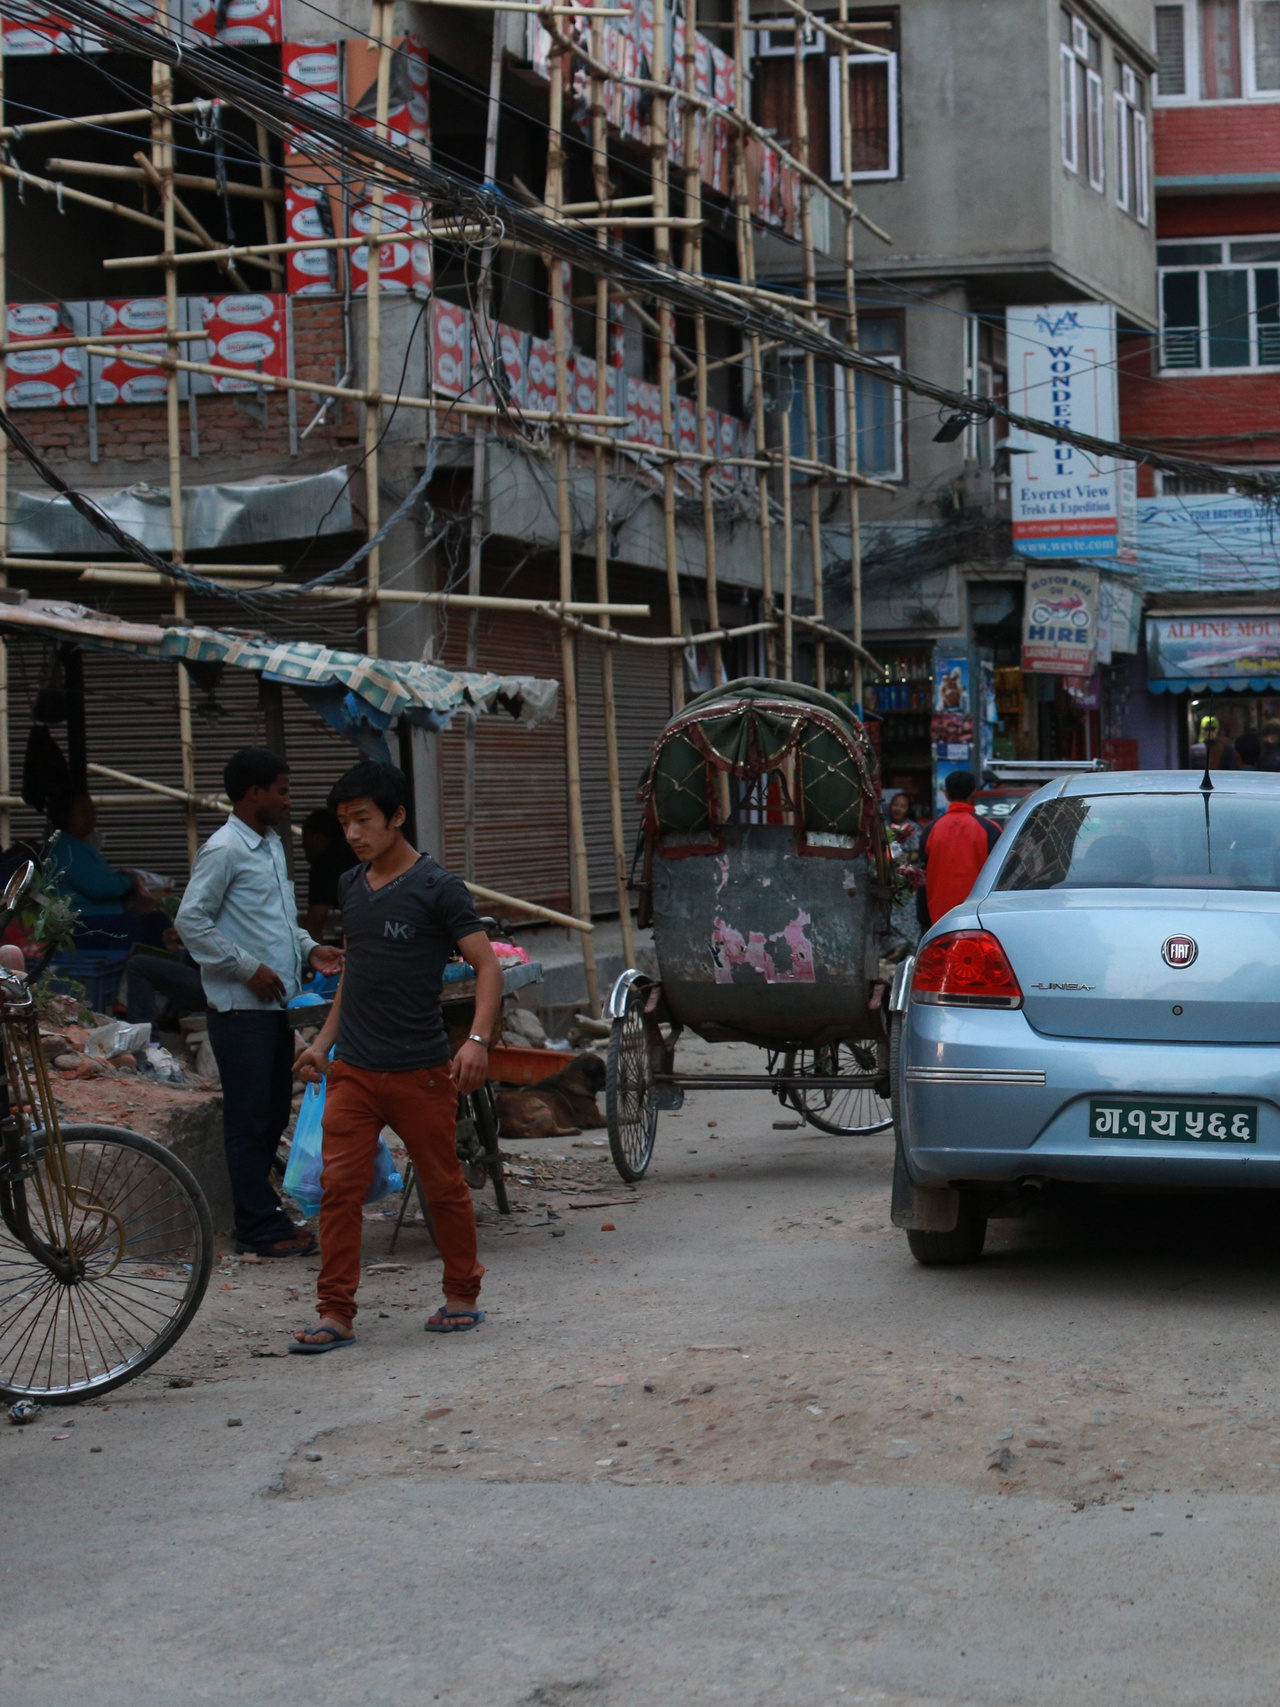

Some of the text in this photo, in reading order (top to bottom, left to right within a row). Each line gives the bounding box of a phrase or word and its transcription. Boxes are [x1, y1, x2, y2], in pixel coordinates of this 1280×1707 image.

[1046, 345, 1074, 477] WONDERUL
[1021, 484, 1109, 501] Everest View
[1021, 501, 1111, 515] Treks & Expedition
[1031, 576, 1092, 596] MOTOR BIKE
[1028, 625, 1087, 643] HIRE
[1167, 621, 1232, 639] ALPINE
[1171, 944, 1190, 959] FIAT
[1031, 981, 1096, 991] LINEA
